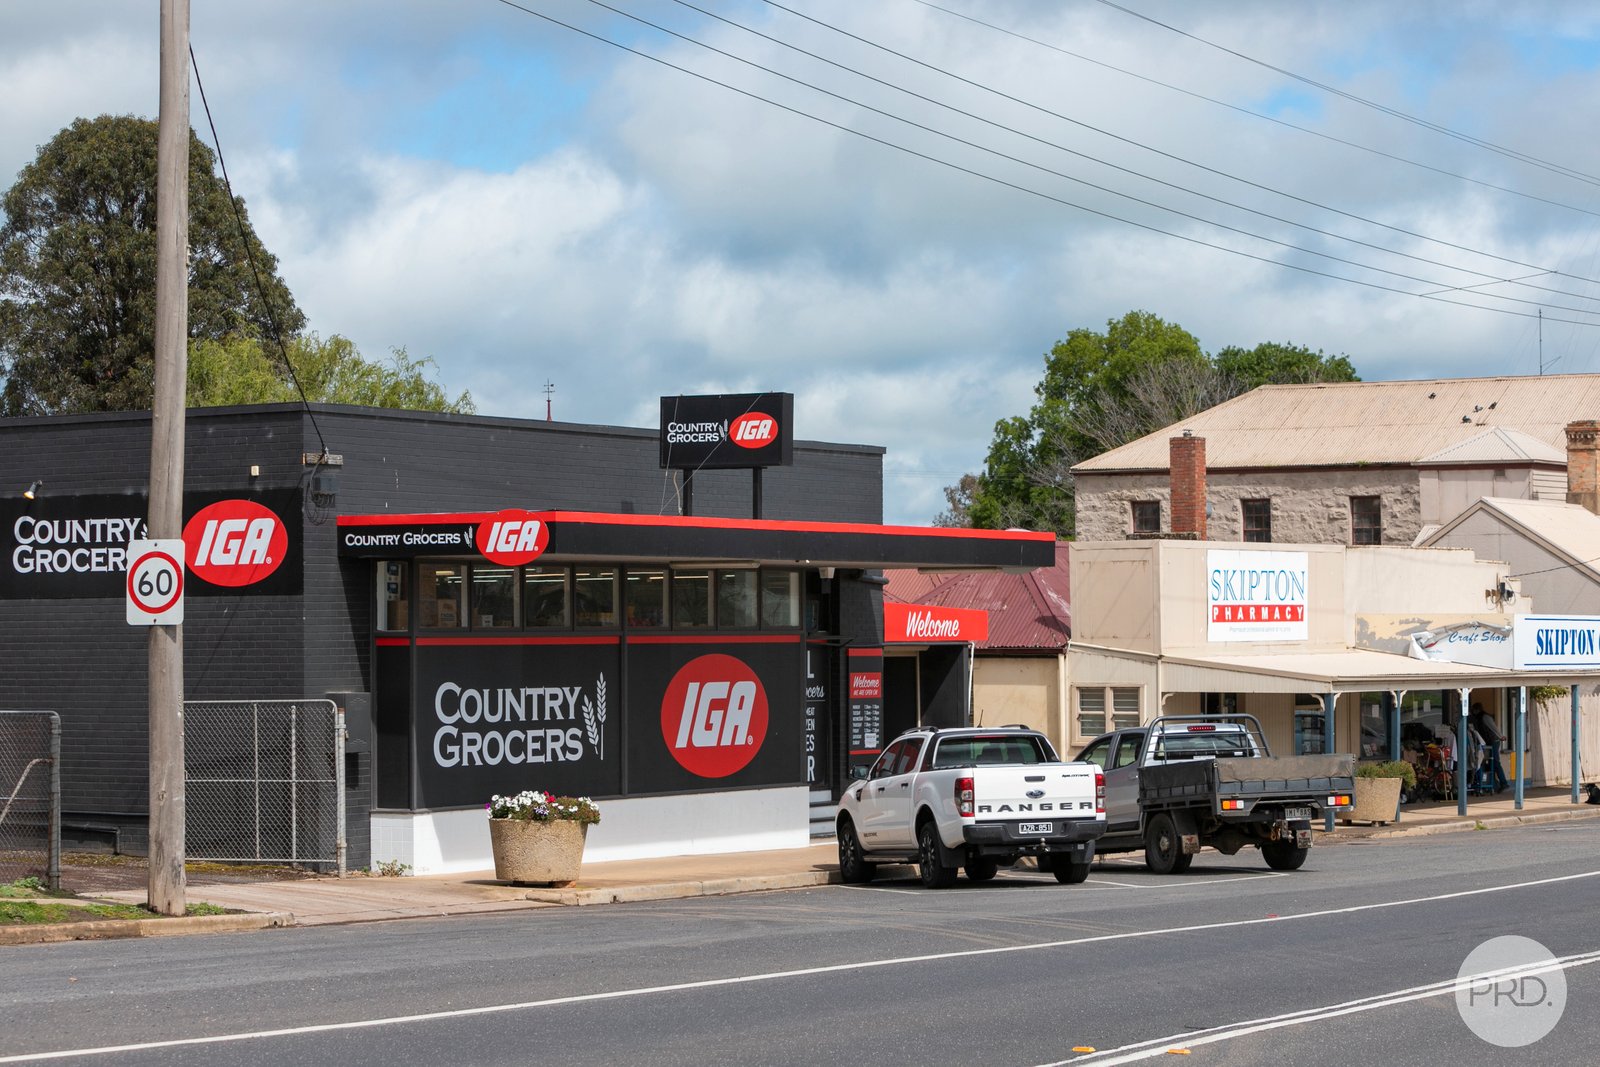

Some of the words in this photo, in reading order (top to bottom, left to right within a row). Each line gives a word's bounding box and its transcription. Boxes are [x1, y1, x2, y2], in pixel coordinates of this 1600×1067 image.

[667, 422, 719, 433] COUNTRY
[667, 432, 720, 443] GROCERS
[736, 420, 772, 440] IGA
[13, 515, 142, 544] COUNTRY
[194, 517, 275, 566] IGA
[345, 533, 401, 546] COUNTRY
[402, 532, 461, 545] GROCERS
[485, 520, 541, 553] IGA
[12, 544, 129, 574] GROCER
[138, 569, 173, 597] 60
[1211, 569, 1306, 601] SKIPTON
[905, 610, 961, 638] Welcome
[1213, 606, 1304, 620] PHARMACY
[1448, 630, 1479, 645] Craft
[1480, 630, 1507, 644] Shop
[1536, 628, 1595, 656] SKIPTON
[806, 685, 825, 698] cers
[853, 674, 880, 689] Welcome
[434, 681, 583, 724] COUNTRY
[675, 680, 757, 748] IGA
[433, 725, 584, 769] GROCERS
[978, 801, 1093, 813] RANGER
